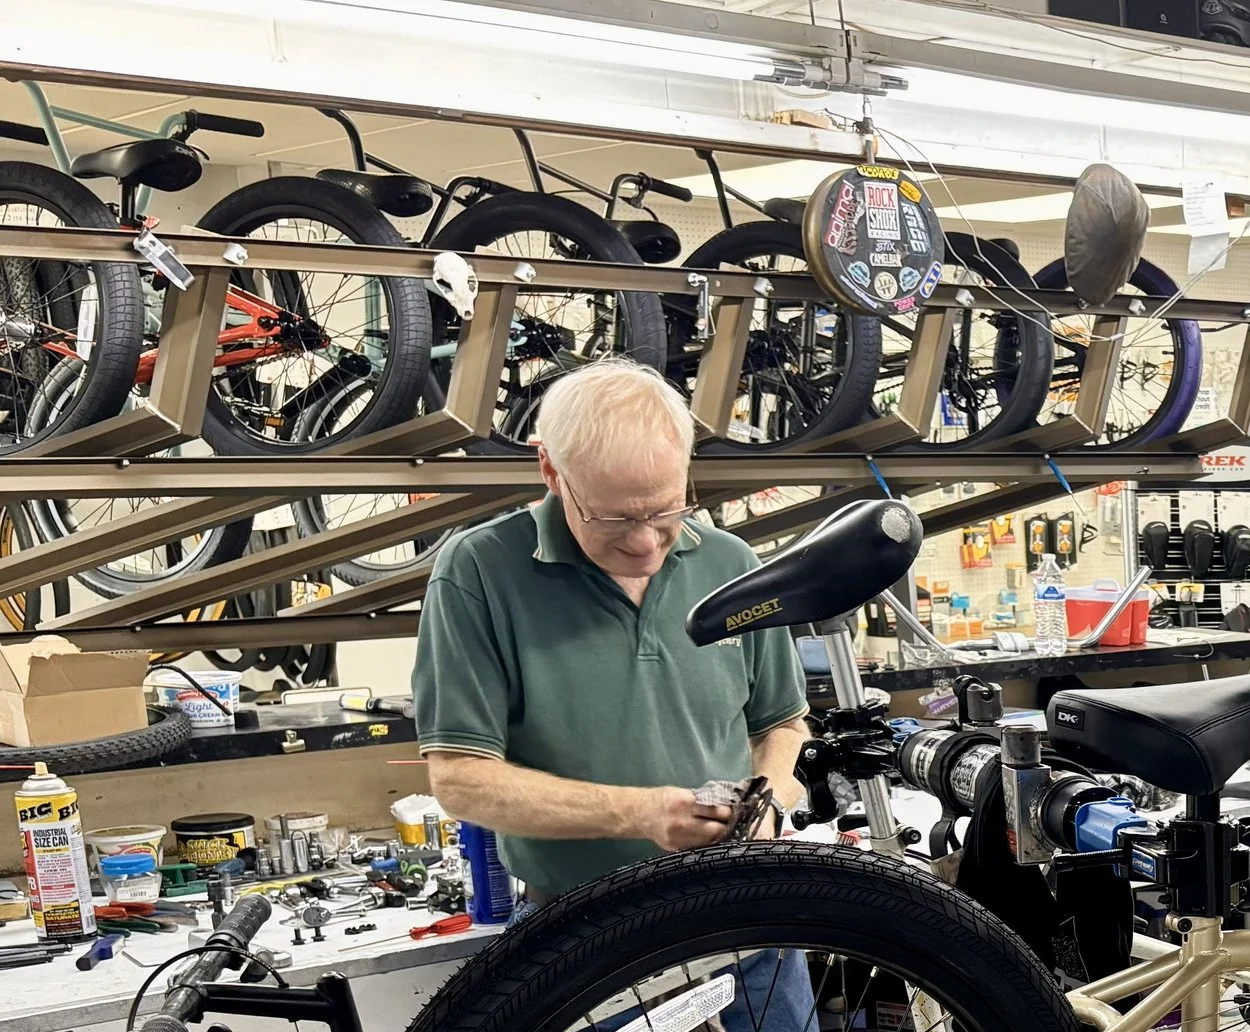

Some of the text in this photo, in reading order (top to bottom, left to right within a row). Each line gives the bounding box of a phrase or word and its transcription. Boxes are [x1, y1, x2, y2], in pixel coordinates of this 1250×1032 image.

[867, 186, 895, 208] ROCK
[827, 180, 855, 248] animal
[869, 208, 898, 231] SHOX
[1200, 456, 1246, 466] REK
[725, 597, 780, 629] AVOCET
[184, 702, 215, 713] Light
[1058, 711, 1077, 724] DK
[33, 828, 67, 838] INDUSTRIAL
[34, 836, 69, 848] SIZE CAN
